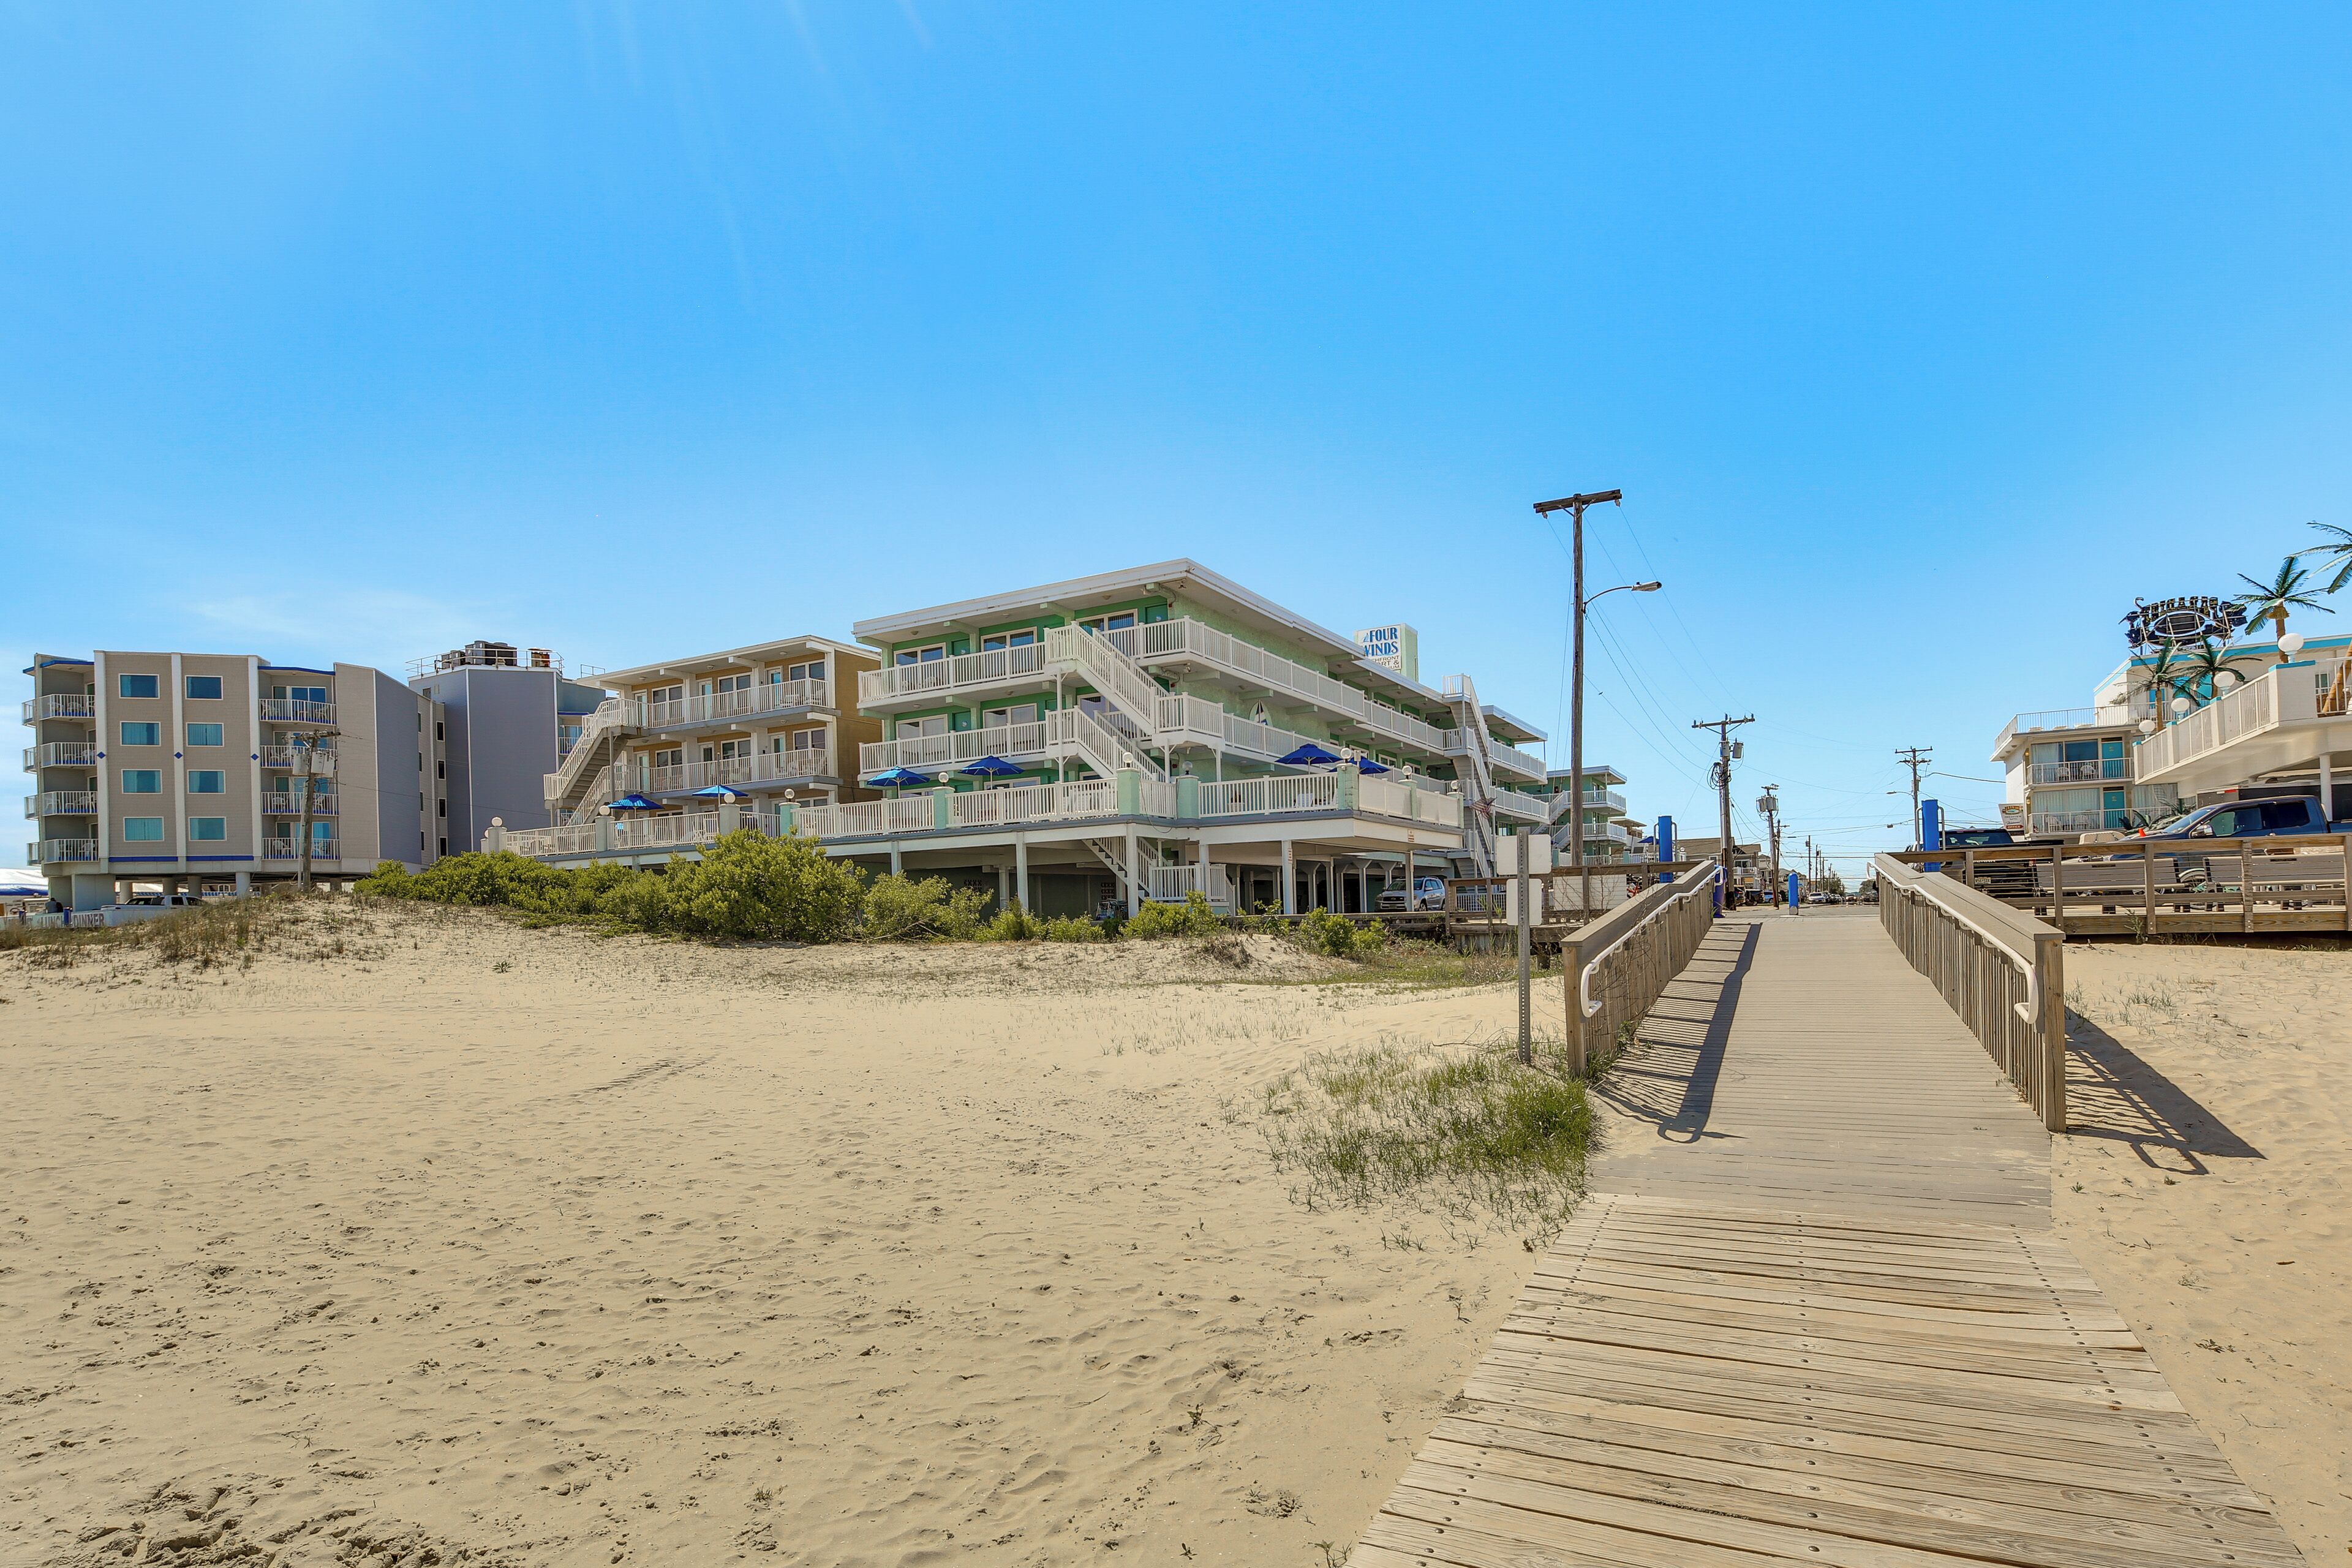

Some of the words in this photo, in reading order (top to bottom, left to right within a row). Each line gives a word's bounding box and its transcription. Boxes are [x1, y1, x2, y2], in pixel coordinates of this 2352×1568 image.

[1370, 627, 1398, 643] FOUR
[1363, 641, 1398, 657] WINDS
[73, 913, 104, 927] DINNER
